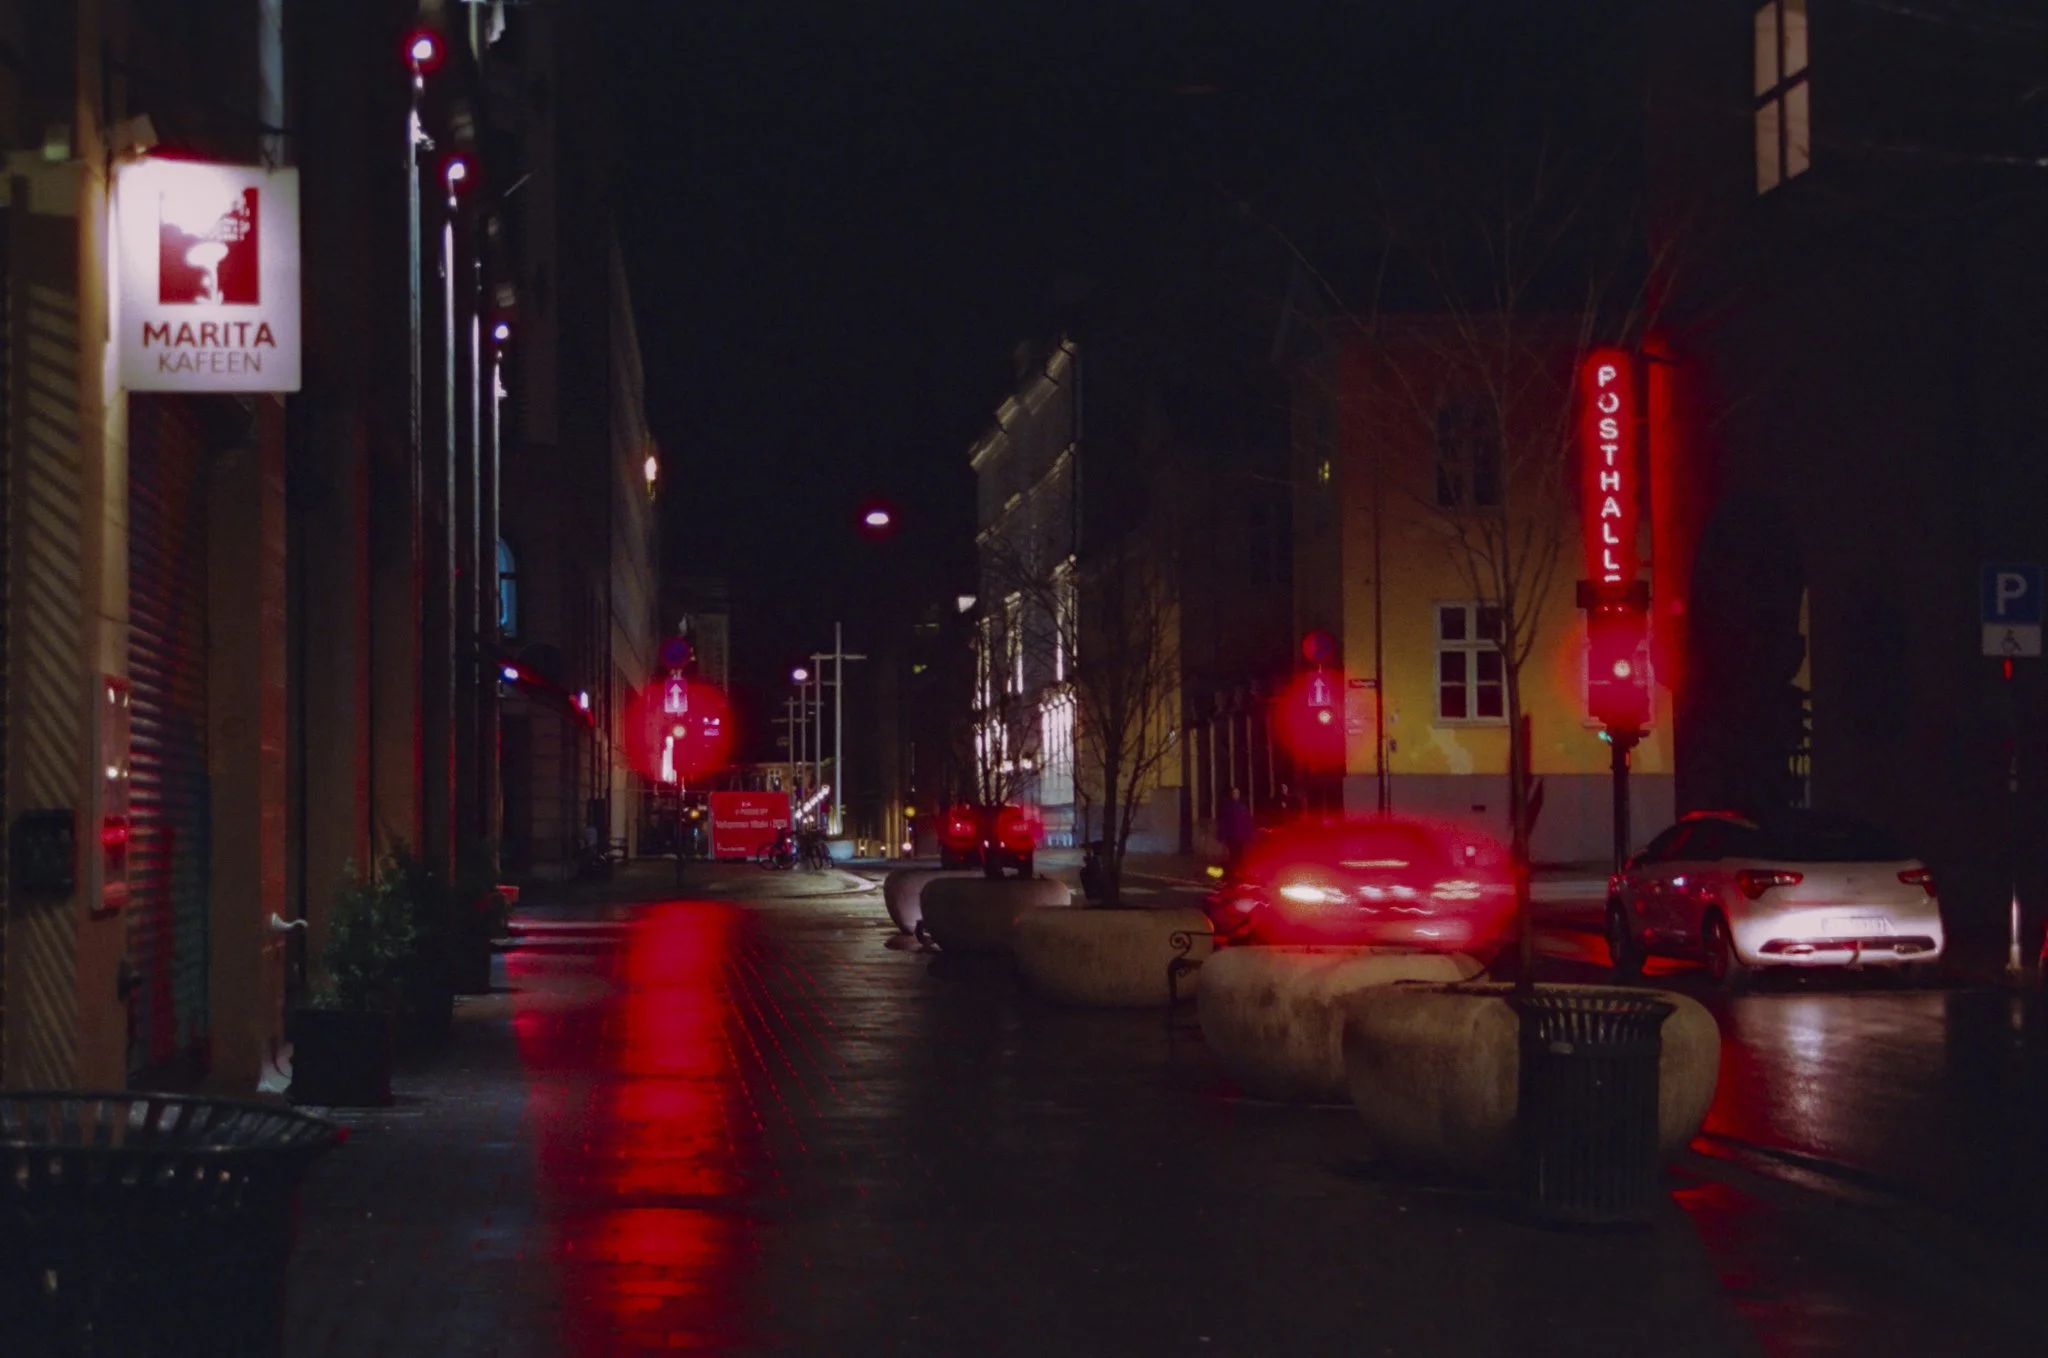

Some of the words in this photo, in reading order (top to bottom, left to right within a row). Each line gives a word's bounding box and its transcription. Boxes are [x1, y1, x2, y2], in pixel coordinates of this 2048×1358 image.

[143, 321, 276, 348] MARITA
[158, 351, 263, 374] KAFEEN
[1597, 364, 1622, 583] POSTHALL
[1996, 572, 2028, 616] P
